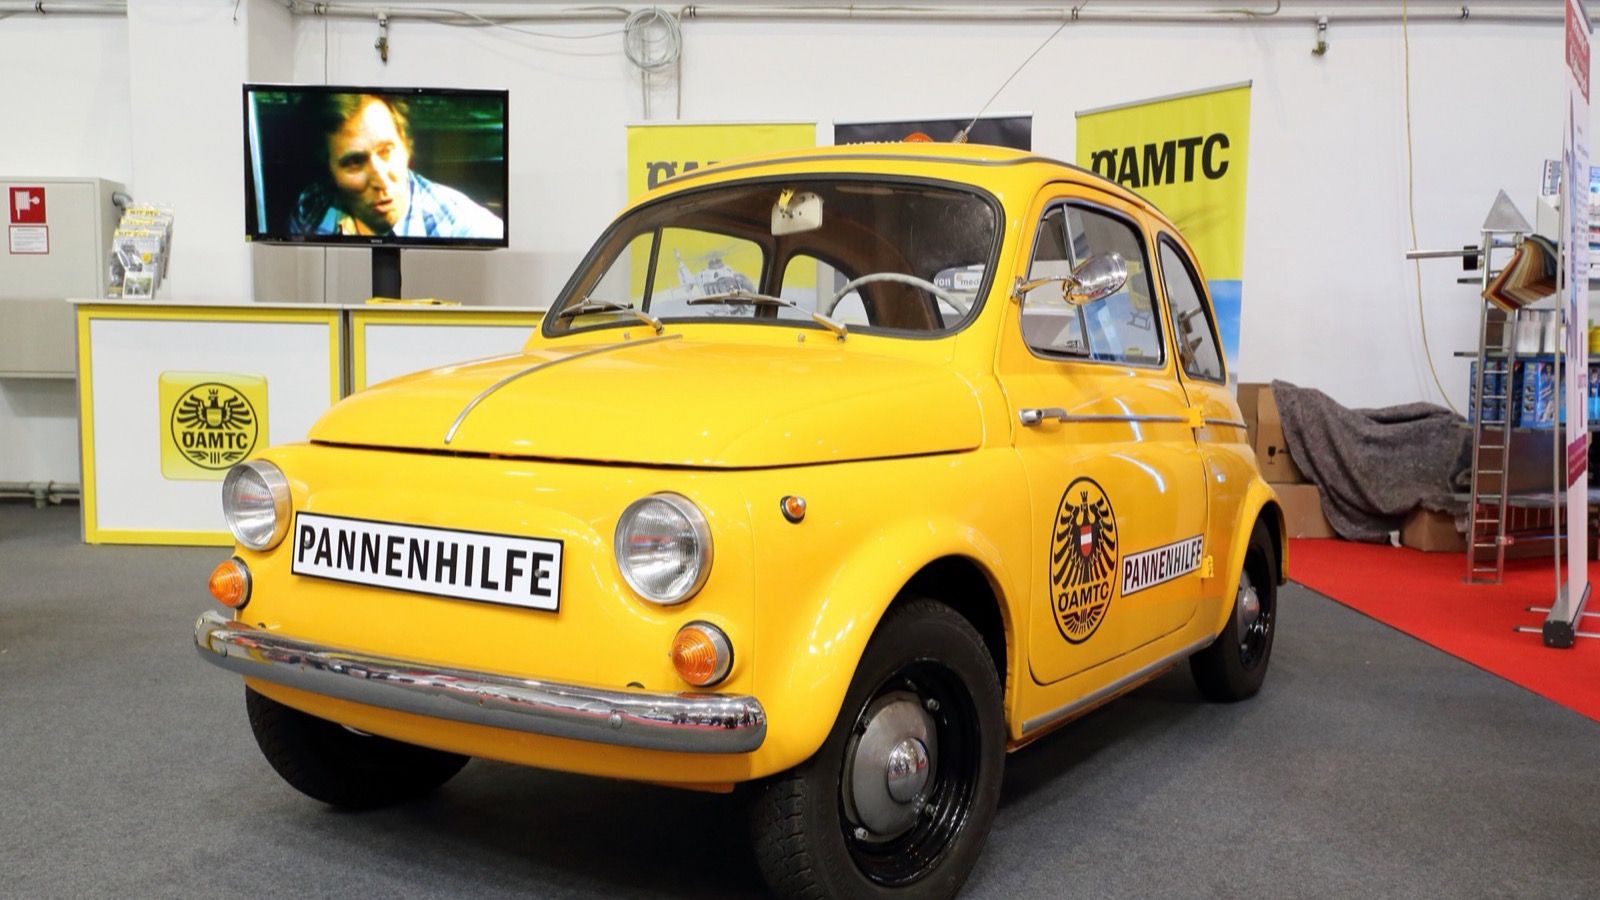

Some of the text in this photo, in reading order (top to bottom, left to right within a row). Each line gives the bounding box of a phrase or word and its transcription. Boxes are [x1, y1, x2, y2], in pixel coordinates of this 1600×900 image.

[1091, 132, 1230, 189] ÖAMTC
[182, 431, 248, 449] ÖAMTC
[298, 524, 554, 597] PANNENHILFE
[1124, 540, 1203, 591] PANNENHILFE
[1058, 581, 1109, 612] ÖAMTC
